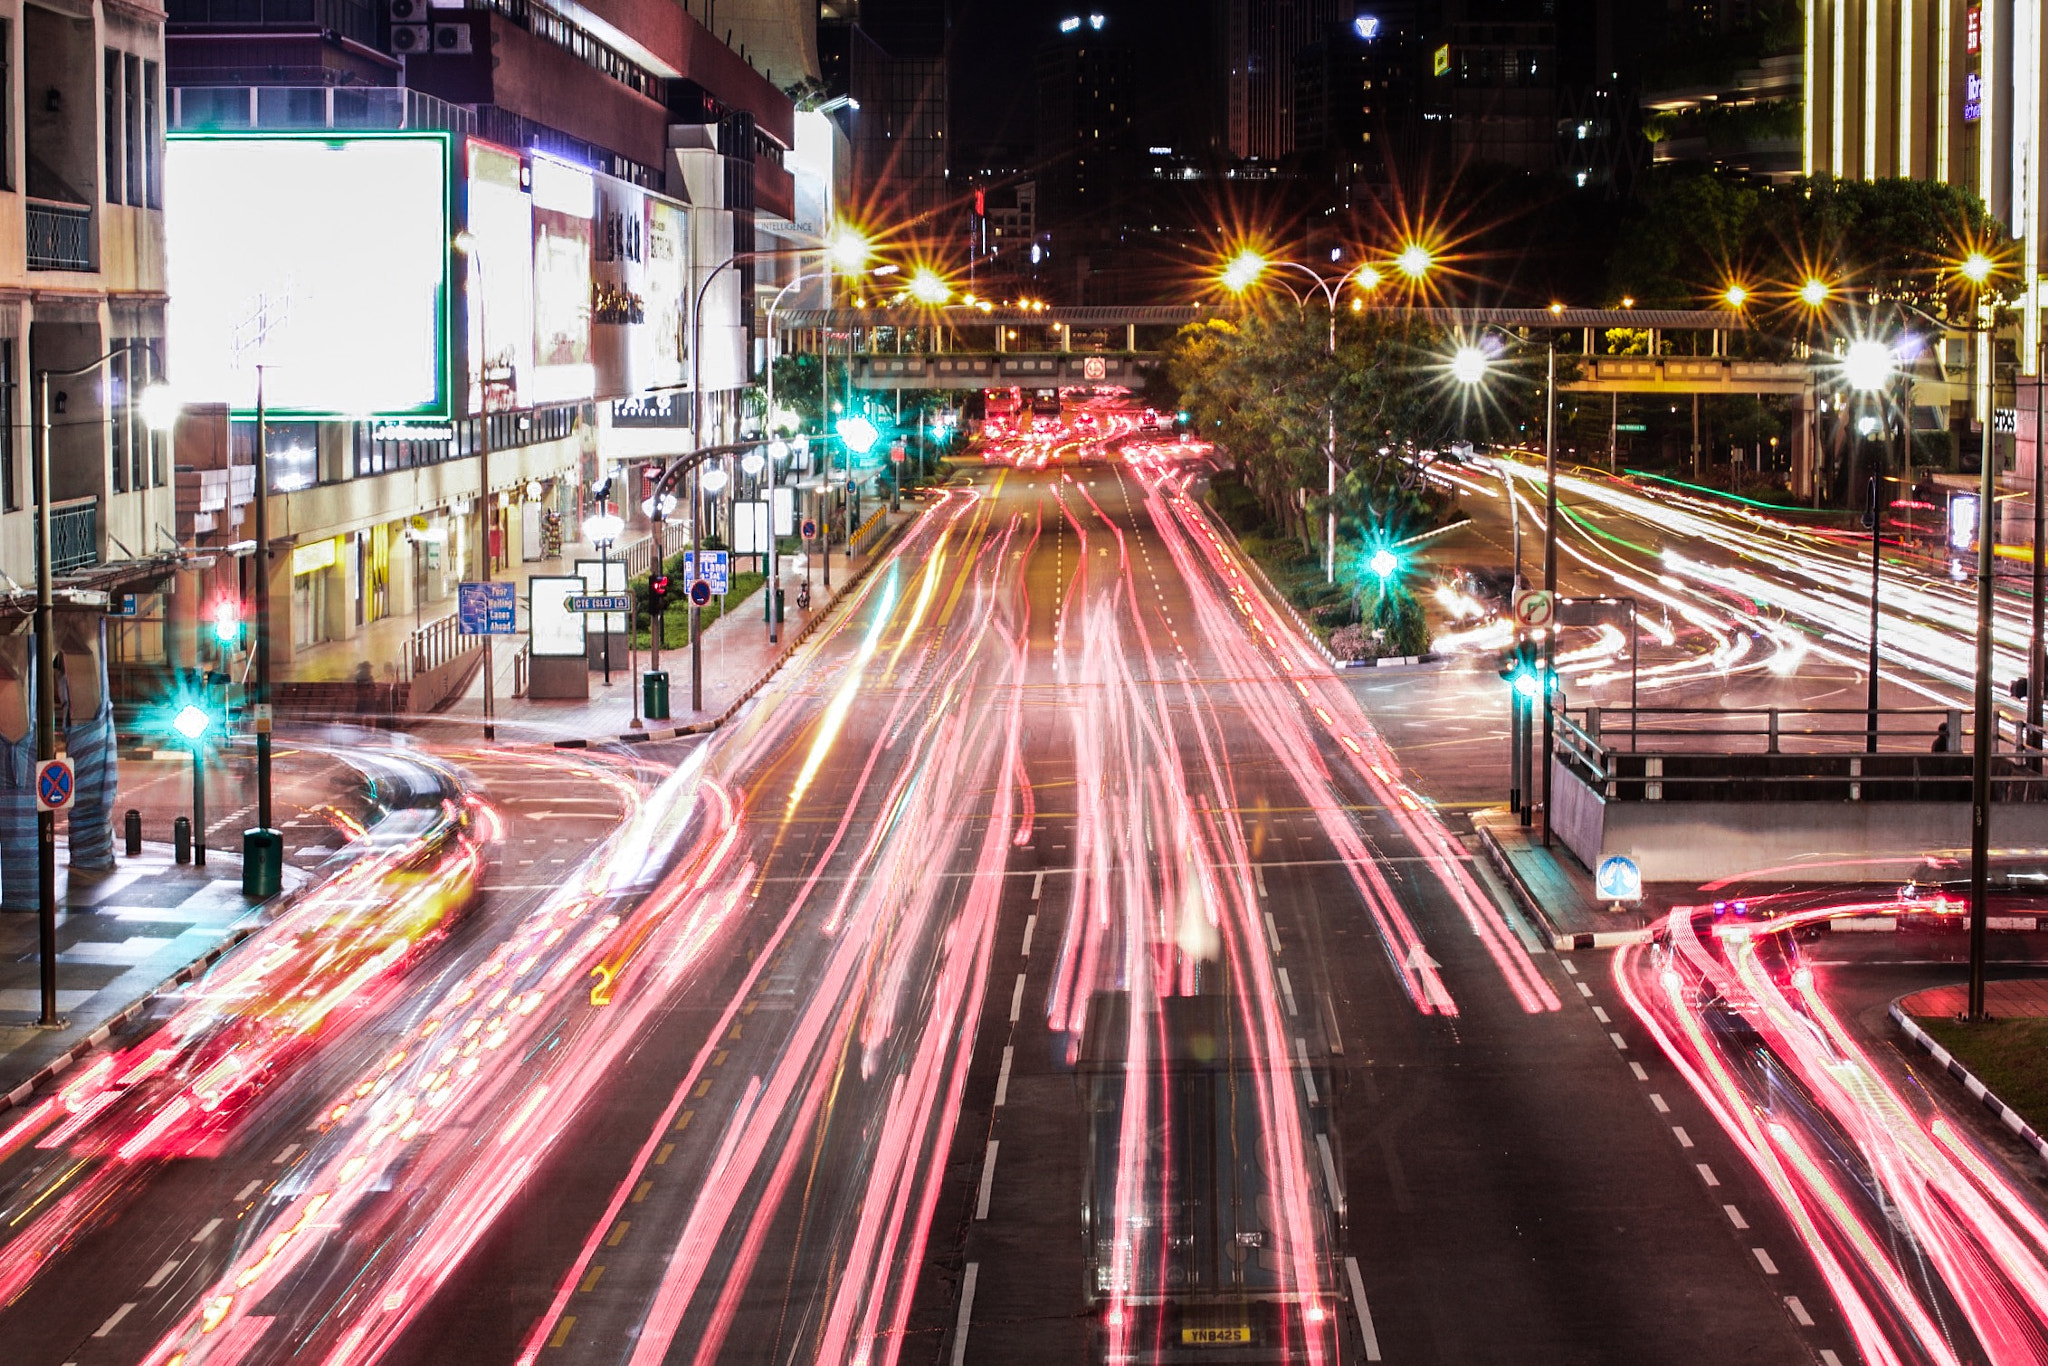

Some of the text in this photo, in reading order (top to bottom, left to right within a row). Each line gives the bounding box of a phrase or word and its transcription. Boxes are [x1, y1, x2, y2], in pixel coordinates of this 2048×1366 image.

[762, 222, 812, 232] INTELLIGENCE
[704, 561, 726, 573] Lane
[575, 598, 612, 608] CTE (SLE)
[490, 610, 510, 620] Lanes
[490, 622, 510, 631] Ahead
[1191, 1330, 1242, 1341] YN842S
